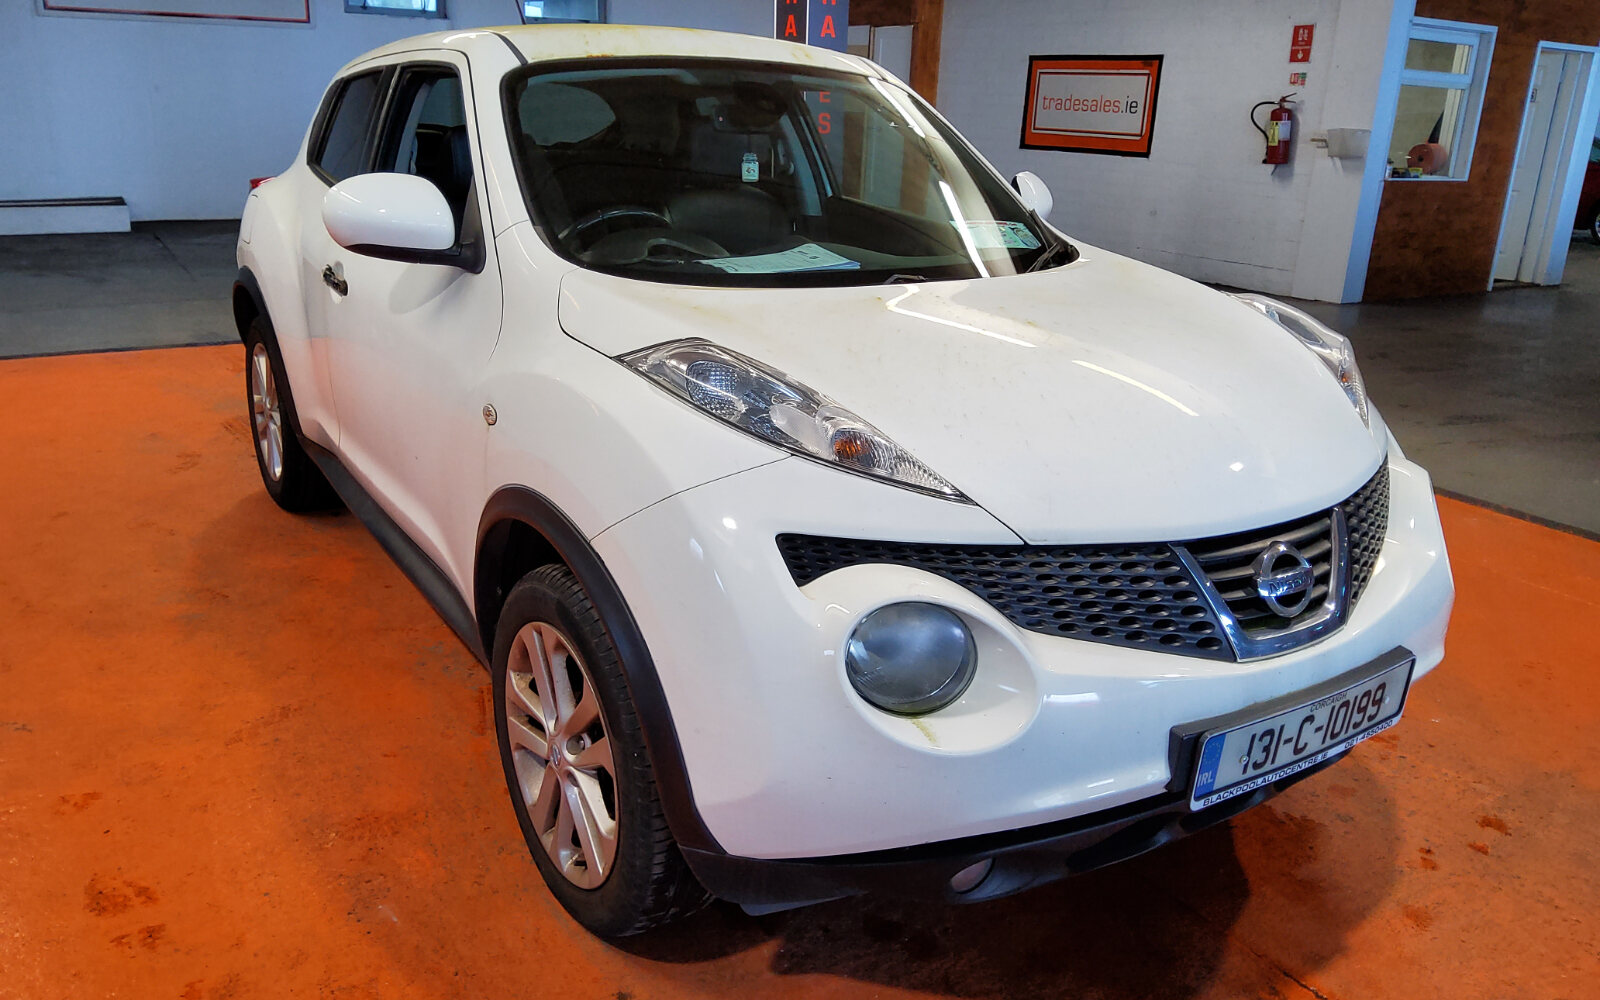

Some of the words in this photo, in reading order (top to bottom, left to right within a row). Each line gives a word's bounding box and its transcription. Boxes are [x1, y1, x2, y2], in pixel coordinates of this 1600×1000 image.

[1042, 93, 1139, 114] tradesales.ie
[1242, 682, 1387, 775] 131-C-10199
[1197, 771, 1213, 787] IRL
